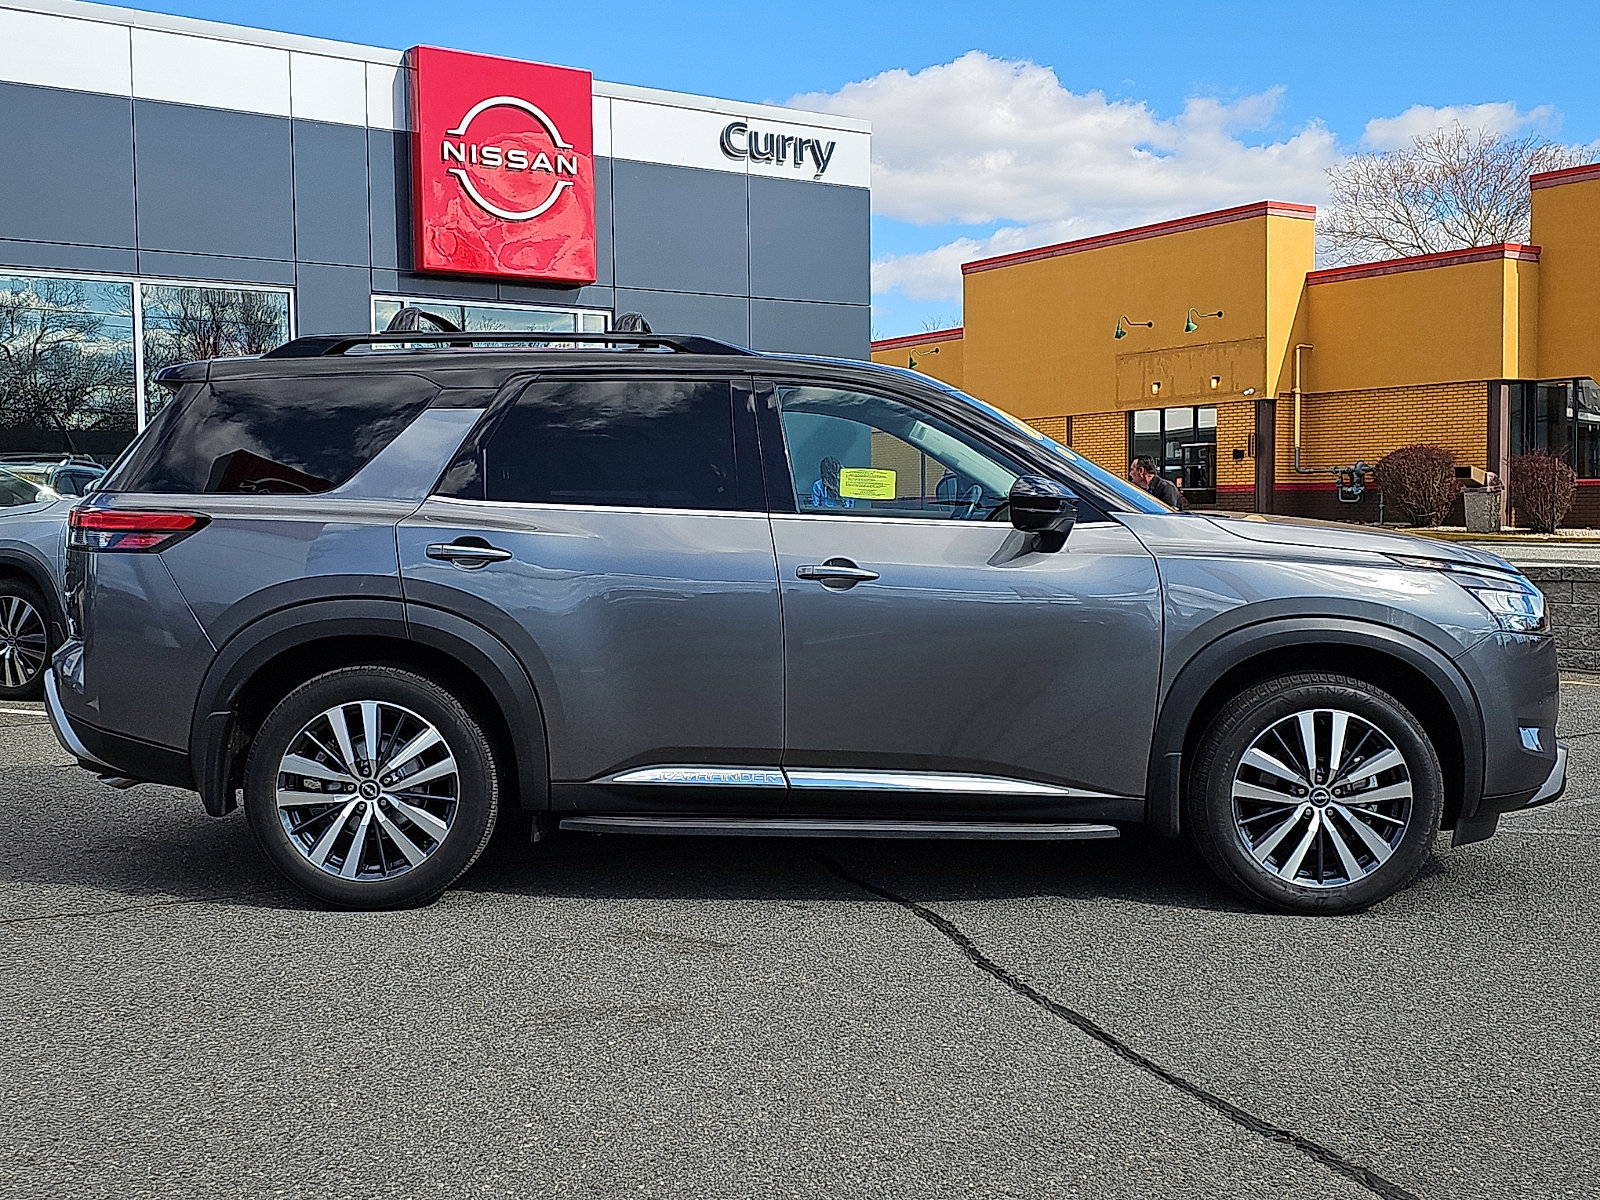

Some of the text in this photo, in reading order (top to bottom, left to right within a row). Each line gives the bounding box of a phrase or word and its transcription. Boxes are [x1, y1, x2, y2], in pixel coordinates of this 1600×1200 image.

[441, 140, 578, 175] NISSAN
[720, 121, 836, 179] Curry
[660, 771, 778, 783] PATHFINDER
